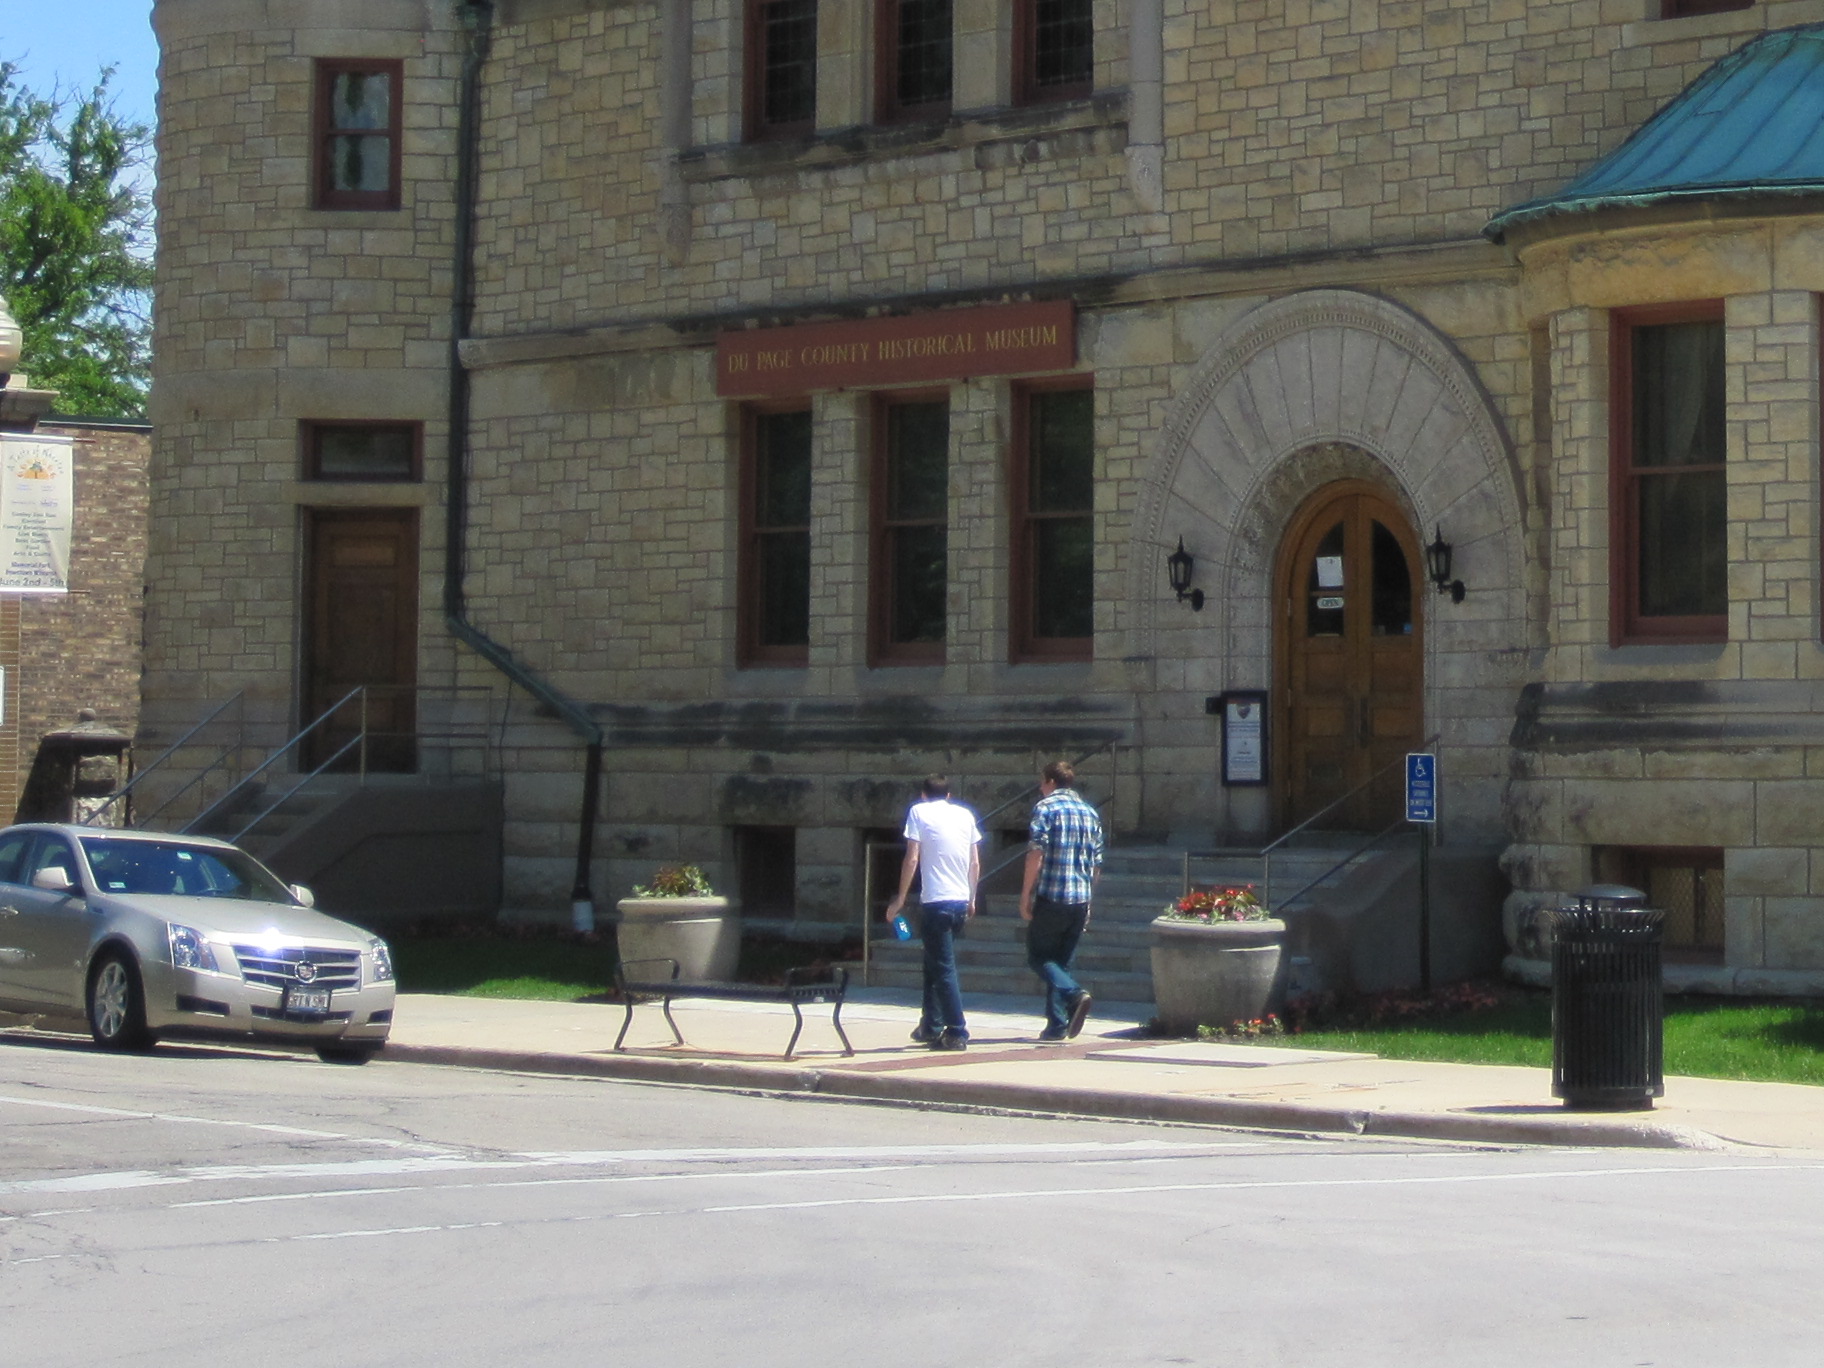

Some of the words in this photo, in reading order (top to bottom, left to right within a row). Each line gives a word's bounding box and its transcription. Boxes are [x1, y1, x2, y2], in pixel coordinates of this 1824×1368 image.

[728, 352, 749, 374] DU
[757, 349, 793, 371] PAGE
[801, 342, 870, 366] COUNTY
[878, 333, 976, 361] HISTORICAL
[985, 325, 1057, 352] MUSEUM
[22, 577, 41, 587] 2nd
[49, 577, 65, 588] 5th
